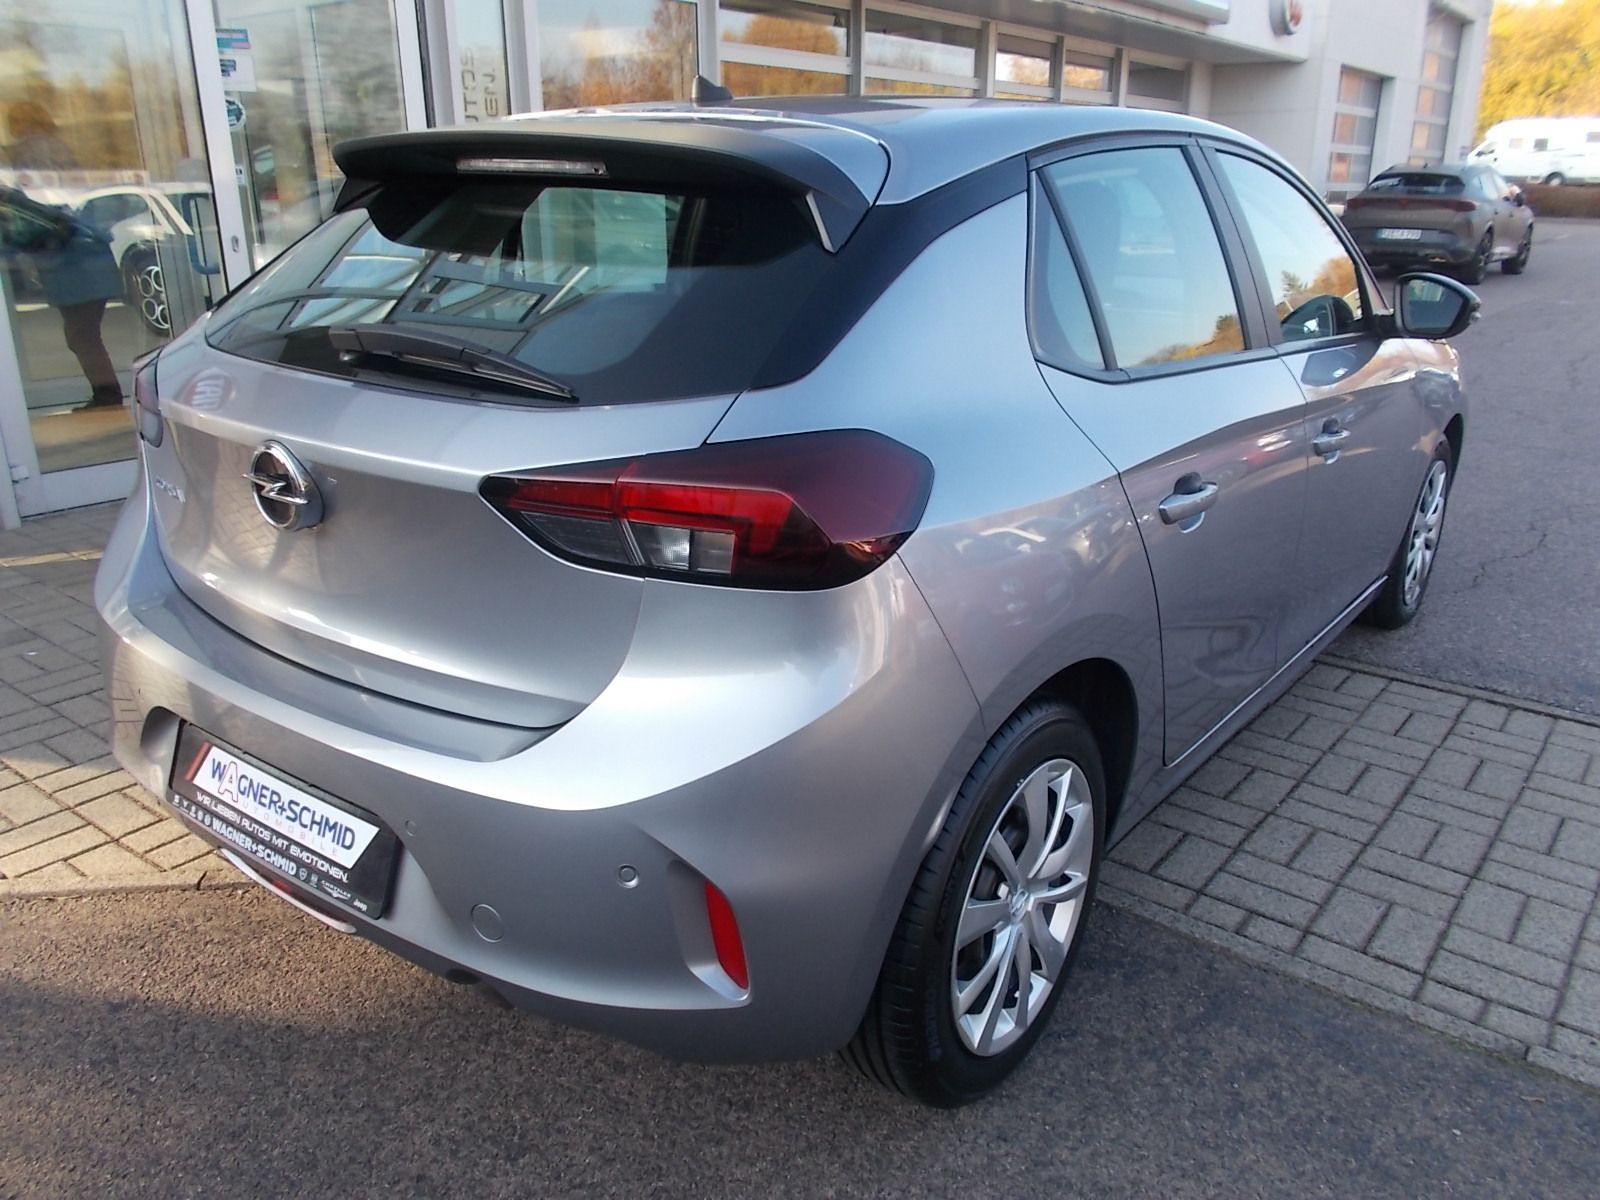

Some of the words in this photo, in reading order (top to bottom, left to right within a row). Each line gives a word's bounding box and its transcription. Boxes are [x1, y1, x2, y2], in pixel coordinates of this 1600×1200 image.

[210, 757, 356, 851] WAGNER+SCHMID
[241, 817, 271, 841] AUTOS
[271, 834, 290, 851] MIT
[212, 816, 297, 876] WAGNER+SCHMID
